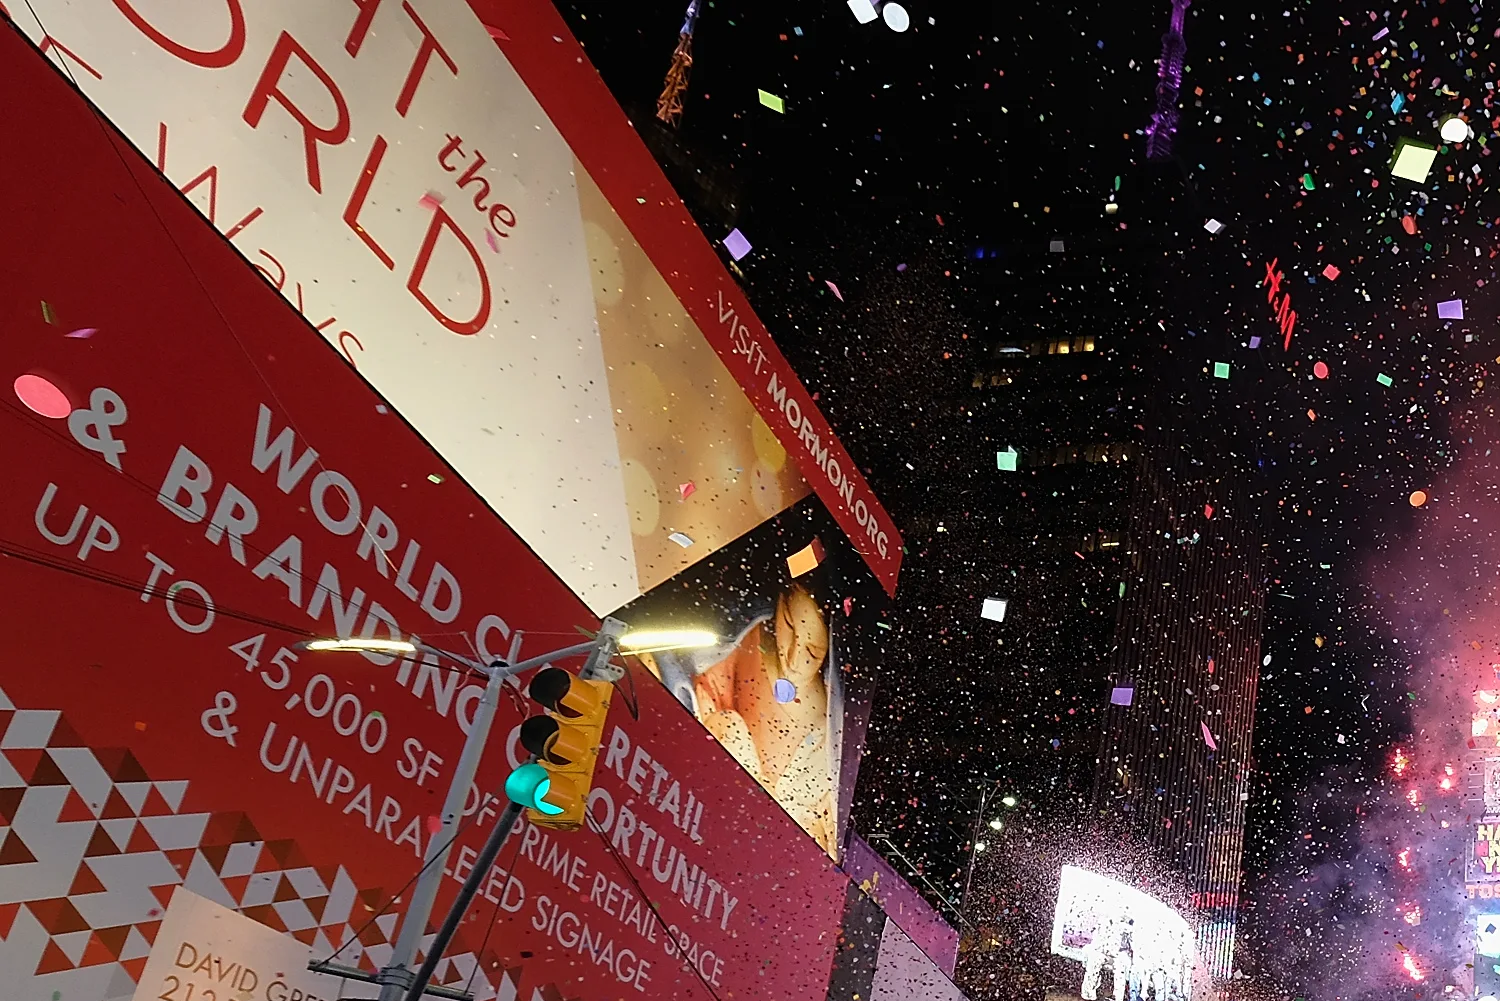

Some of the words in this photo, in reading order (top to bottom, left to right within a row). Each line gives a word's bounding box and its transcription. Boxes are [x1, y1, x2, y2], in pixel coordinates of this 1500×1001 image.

[437, 132, 517, 238] the
[67, 386, 129, 473] &
[718, 290, 767, 375] VISIT
[766, 372, 889, 560] MORMON.ORG
[34, 482, 120, 561] UP
[140, 551, 216, 634] TO
[228, 633, 388, 754] 45,000
[396, 737, 444, 786] SF
[504, 817, 588, 893] PRIME
[590, 871, 657, 944] RETAIL
[663, 924, 725, 987] SPACE
[251, 402, 463, 624] WORLD
[604, 725, 704, 845] RETAIL
[174, 941, 258, 993] DAVID
[201, 690, 239, 748] &
[531, 895, 652, 992] SIGNAGE
